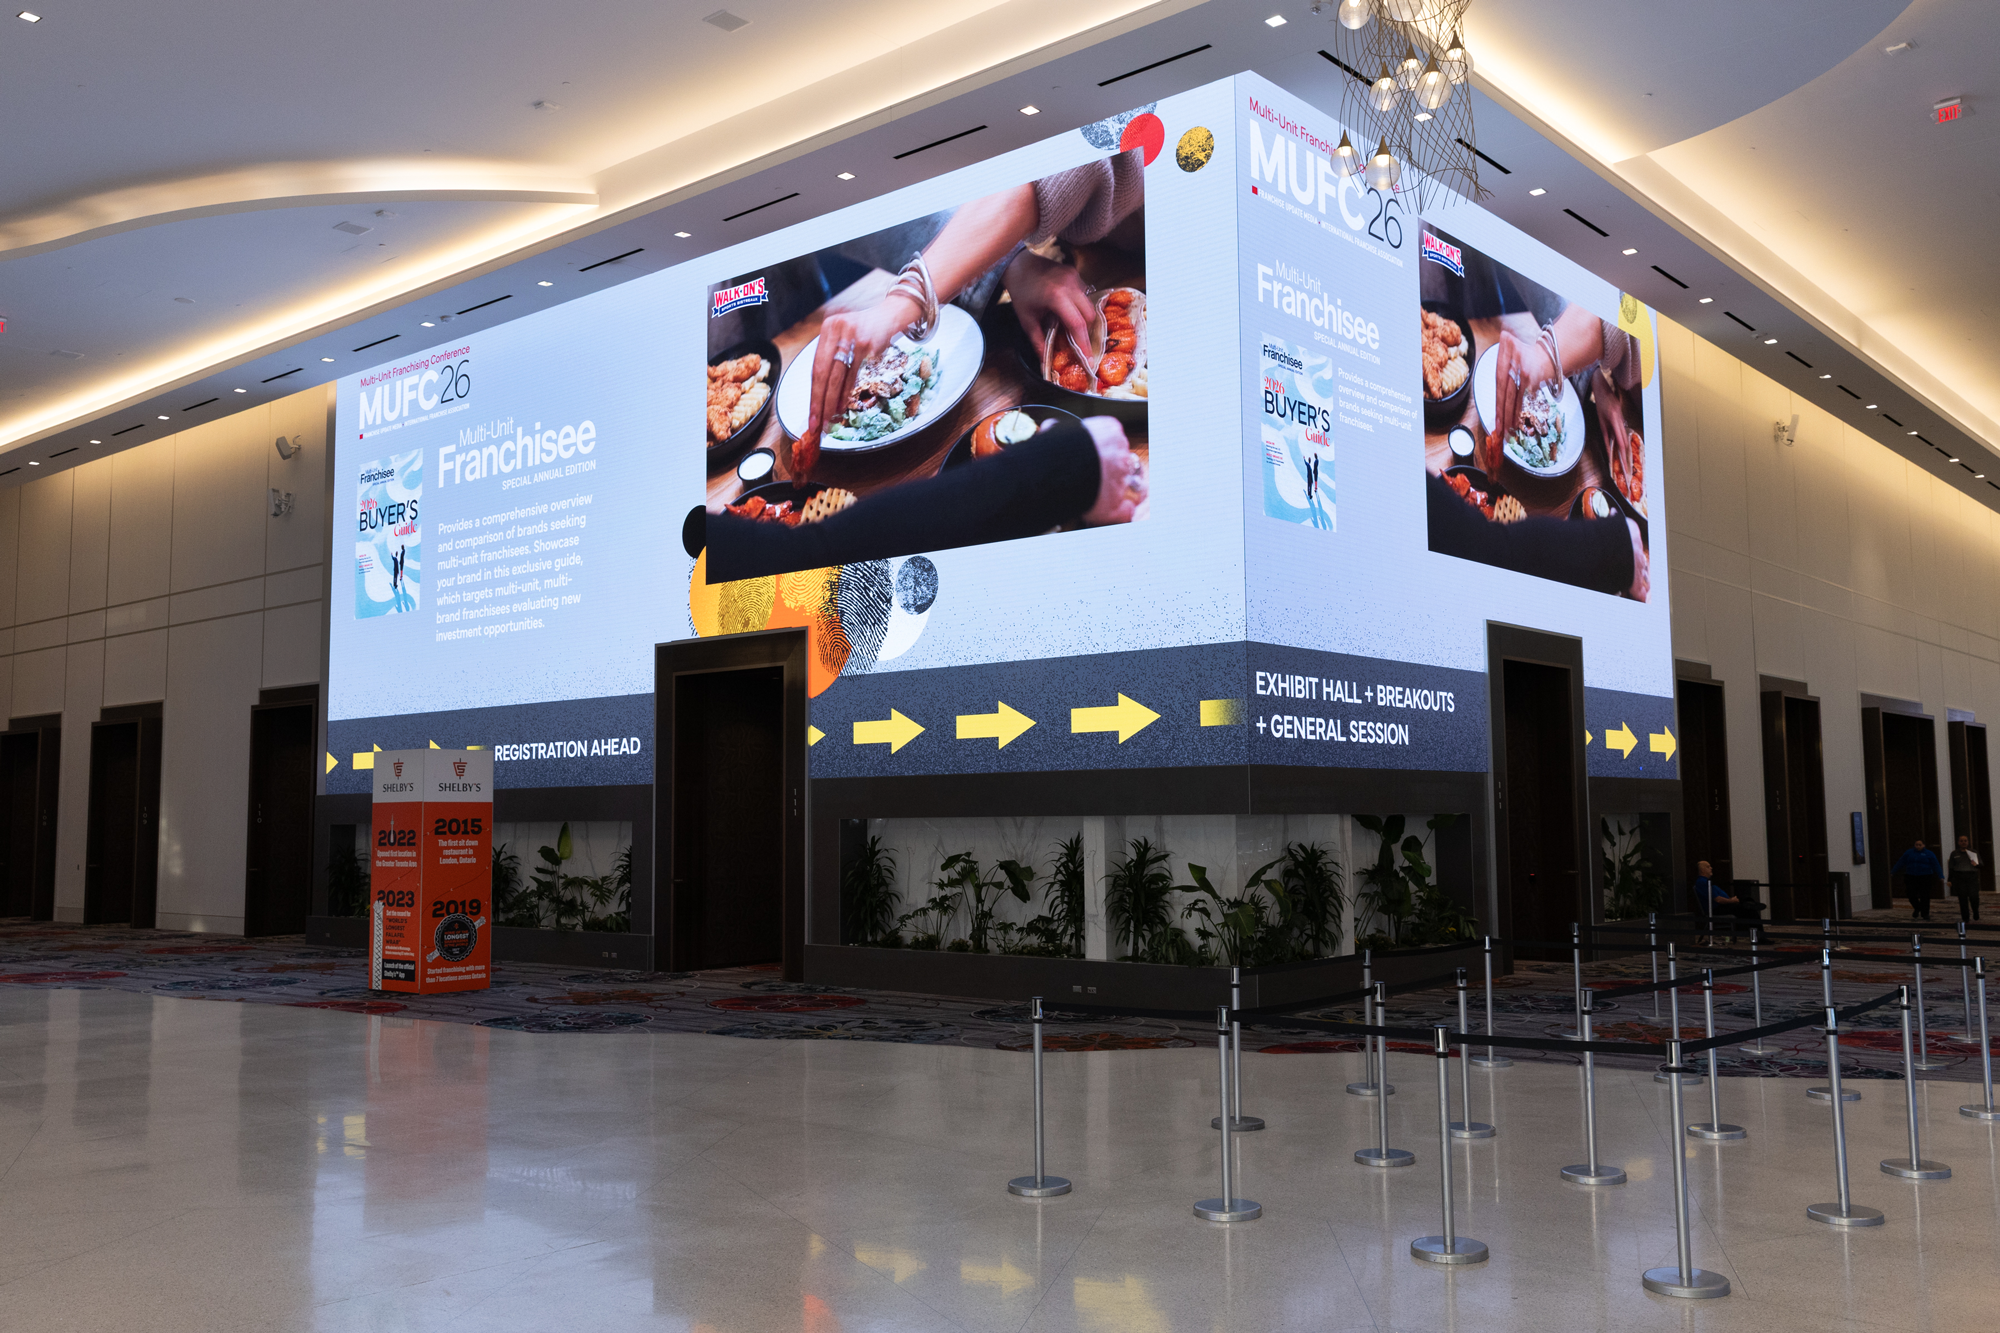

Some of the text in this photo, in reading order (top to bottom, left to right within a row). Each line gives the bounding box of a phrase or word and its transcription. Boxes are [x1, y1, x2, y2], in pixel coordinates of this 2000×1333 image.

[1250, 96, 1336, 156] Multi-Unit Franchi
[1938, 105, 1959, 123] EXIT
[1258, 187, 1403, 268] FRANCHISE UPDATE MEDIA INTERNATIONAL FRANCHISE ASSOCIATION
[1276, 260, 1321, 294] Multi-Unit
[722, 303, 736, 311] SPORTS
[1258, 263, 1379, 349] Franchisee
[1264, 344, 1302, 370] Franchisee
[1314, 331, 1380, 365] SPECIAL ANNUAL EDITION
[360, 346, 470, 388] Multi-Unit Franchising Conference
[1264, 376, 1284, 395] 2026
[1338, 367, 1363, 385] Provides
[1370, 382, 1411, 403] comprehensive
[1265, 389, 1330, 432] BUYER'S
[1339, 385, 1417, 419] overview and comparison of
[1339, 397, 1412, 431] brands seeking multi-unit
[460, 417, 514, 447] Multi-Unit
[1305, 427, 1330, 447] Guide
[1339, 412, 1374, 432] franchisees.
[438, 420, 596, 488] Franchisee
[361, 468, 394, 484] Franchisee
[502, 459, 596, 490] SPECIAL ANNUAL EDITION
[360, 498, 377, 511] 2026
[360, 500, 418, 532] BUYER'S
[438, 494, 592, 535] Provides a comprehensive overview
[394, 520, 417, 536] Guide
[438, 514, 586, 552] and comparison of brands seeking
[438, 535, 579, 570] multi-unit franchisees. Showcase
[437, 552, 583, 592] your brand in this exclusive guide,
[437, 573, 572, 606] which targets multi-unit, multi-
[436, 593, 581, 624] brand franchisees evaluating new
[436, 616, 544, 642] investment opportunities.
[1256, 671, 1454, 712] EXHIBIT HALL + BREAKOUTS
[1256, 714, 1409, 745] + GENERAL SESSION
[495, 737, 640, 761] REGISTRATION AHEAD
[383, 783, 413, 792] SHELBY'S
[438, 783, 481, 792] SHELBY'S
[378, 830, 416, 846] 2022
[435, 818, 482, 835] 2015
[377, 850, 390, 858] Opened
[378, 890, 414, 907] 2023
[432, 899, 481, 918] 2019
